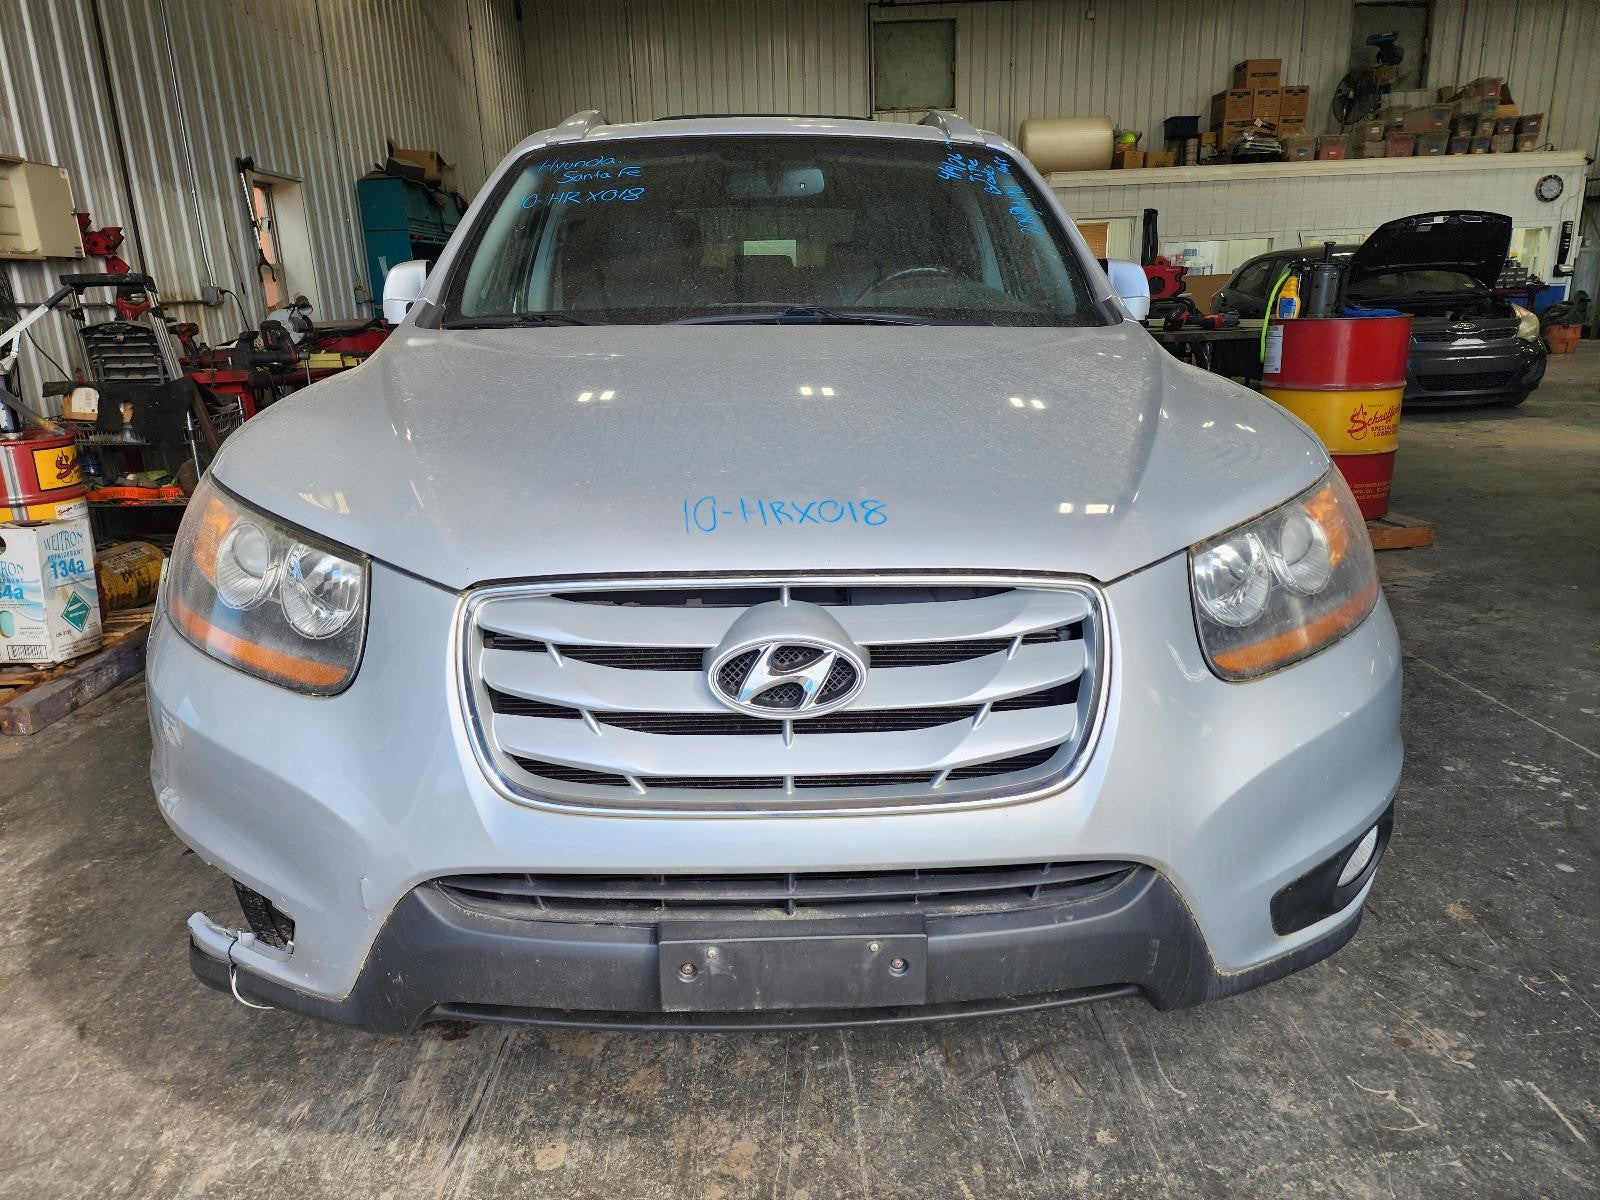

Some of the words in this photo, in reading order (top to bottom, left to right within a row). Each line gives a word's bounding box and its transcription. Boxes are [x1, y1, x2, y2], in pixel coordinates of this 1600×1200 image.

[556, 170, 612, 184] Santa
[684, 495, 889, 534] 10-HRX018
[43, 529, 84, 552] WEITRON
[0, 561, 24, 577] RON
[50, 557, 86, 580] 134a
[0, 584, 25, 600] 4a
